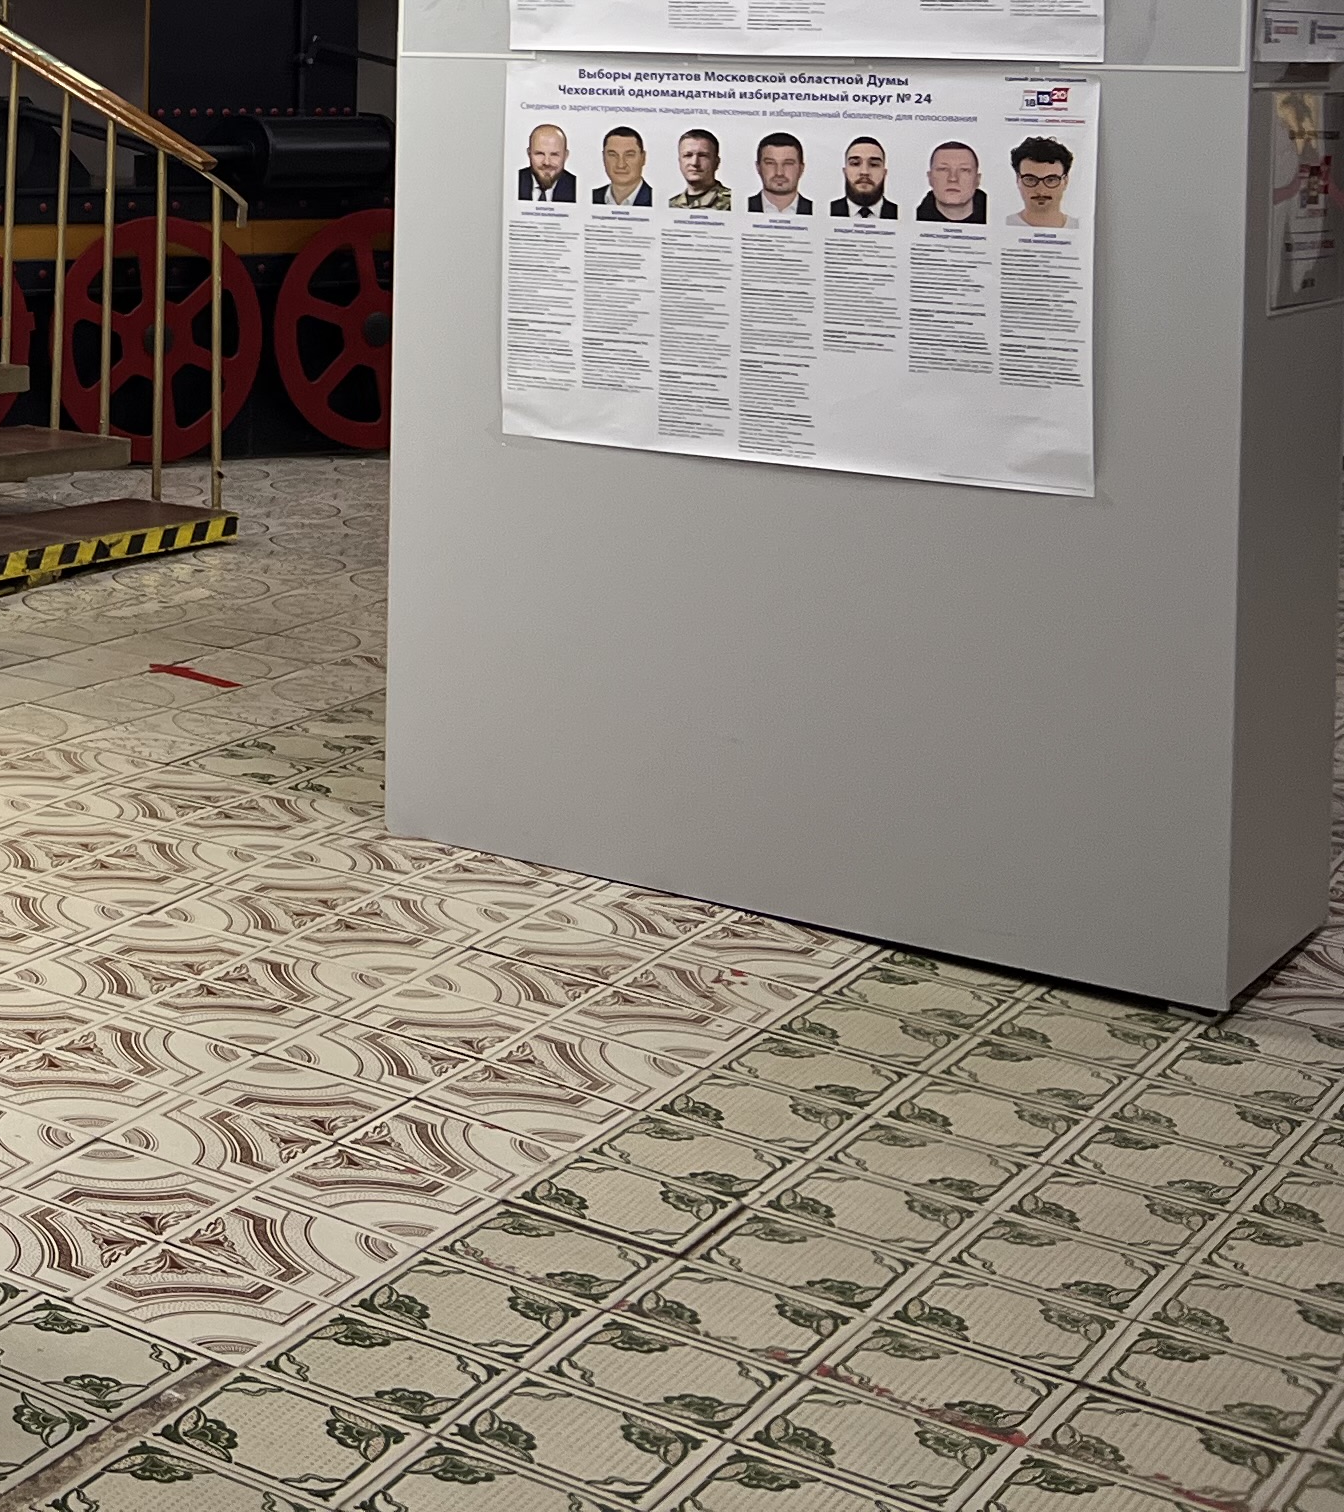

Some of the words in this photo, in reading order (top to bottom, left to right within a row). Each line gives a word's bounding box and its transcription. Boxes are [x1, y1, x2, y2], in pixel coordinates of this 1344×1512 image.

[578, 68, 632, 82] Выборы
[634, 71, 701, 84] депутатов
[704, 71, 787, 84] Московской
[789, 73, 864, 85] областной
[866, 74, 909, 88] Думы
[558, 84, 626, 96] Чеховский
[628, 87, 736, 100] одномандатный
[739, 89, 849, 103] избирательный
[852, 92, 893, 105] округ
[896, 93, 912, 104] №
[914, 93, 933, 104] 24
[842, 110, 893, 121] бюллетень
[895, 113, 913, 122] для
[914, 114, 978, 123] голосования
